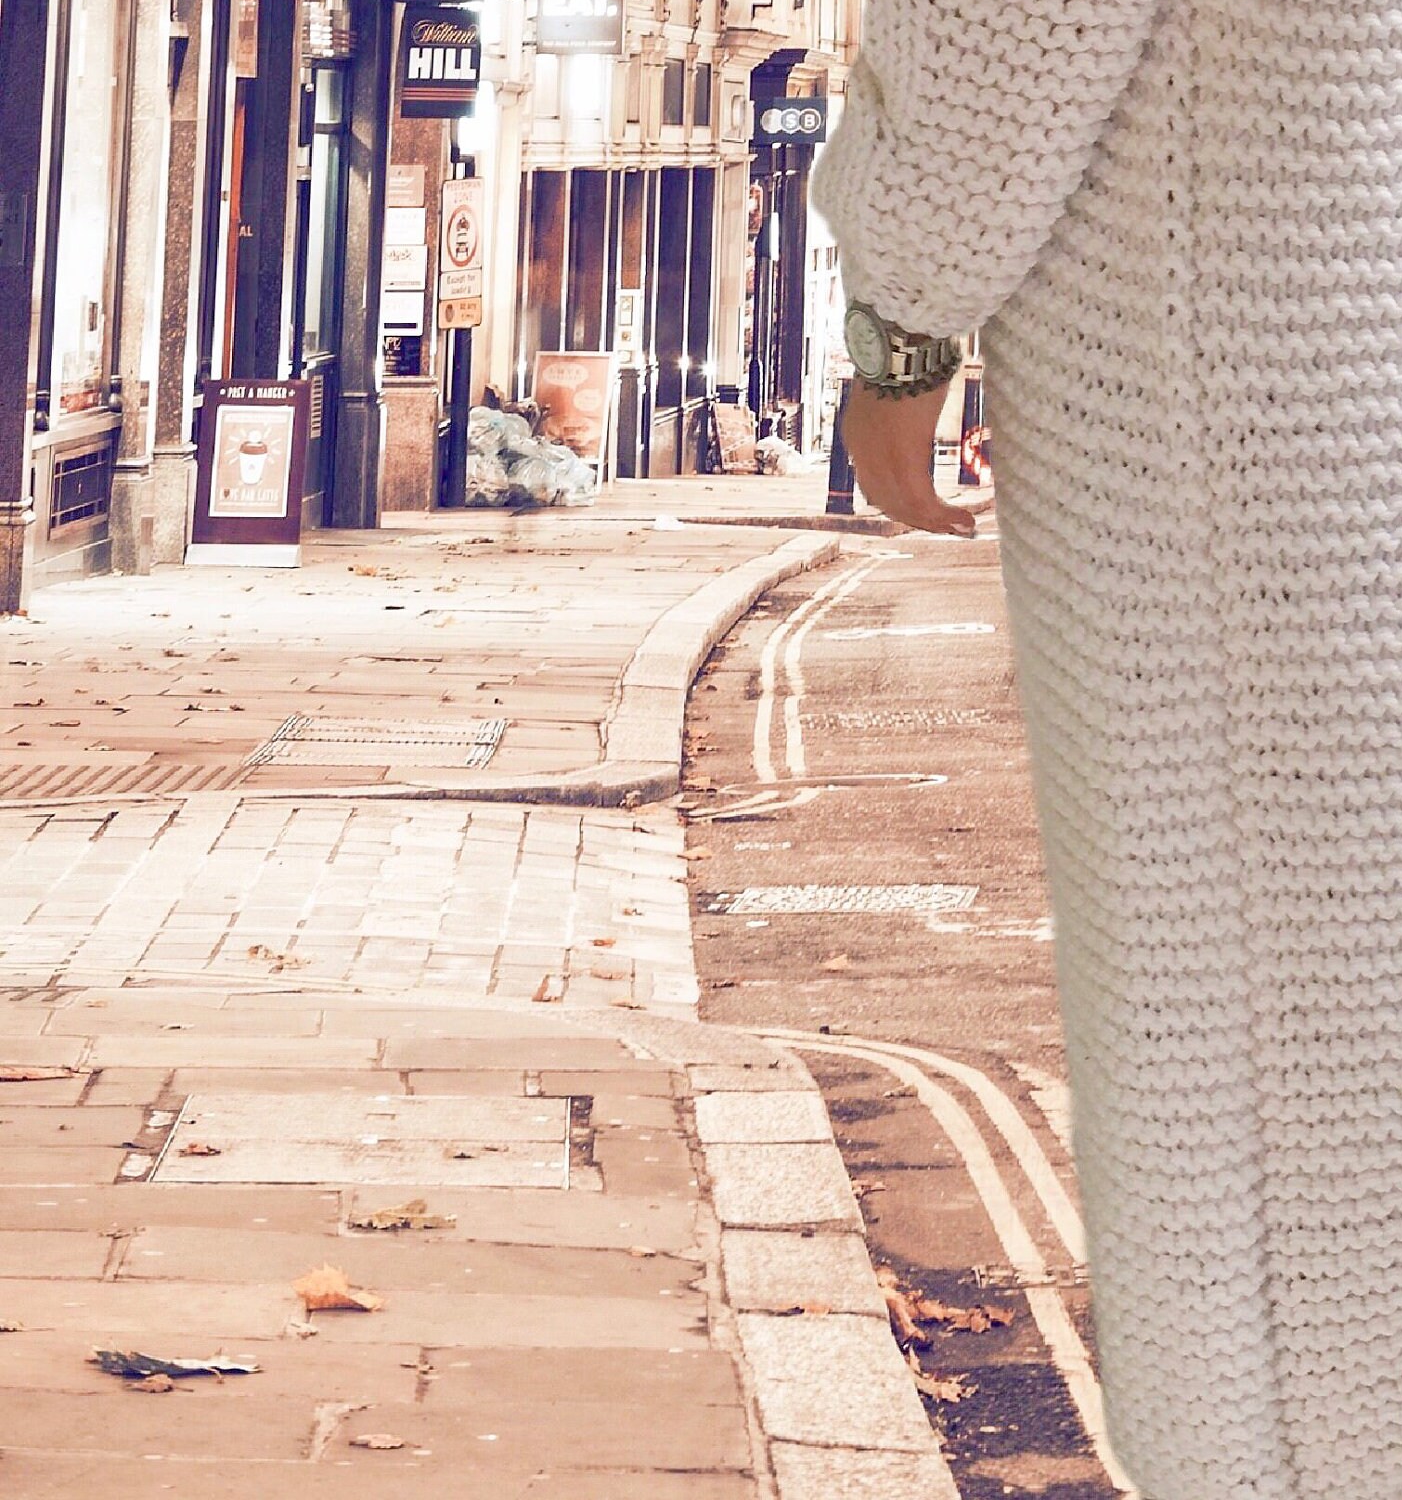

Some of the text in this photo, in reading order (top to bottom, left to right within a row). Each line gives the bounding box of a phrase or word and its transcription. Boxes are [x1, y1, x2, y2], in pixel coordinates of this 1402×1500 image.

[413, 19, 480, 45] William
[408, 48, 476, 79] HILL
[227, 387, 246, 398] PRET
[248, 387, 254, 398] A
